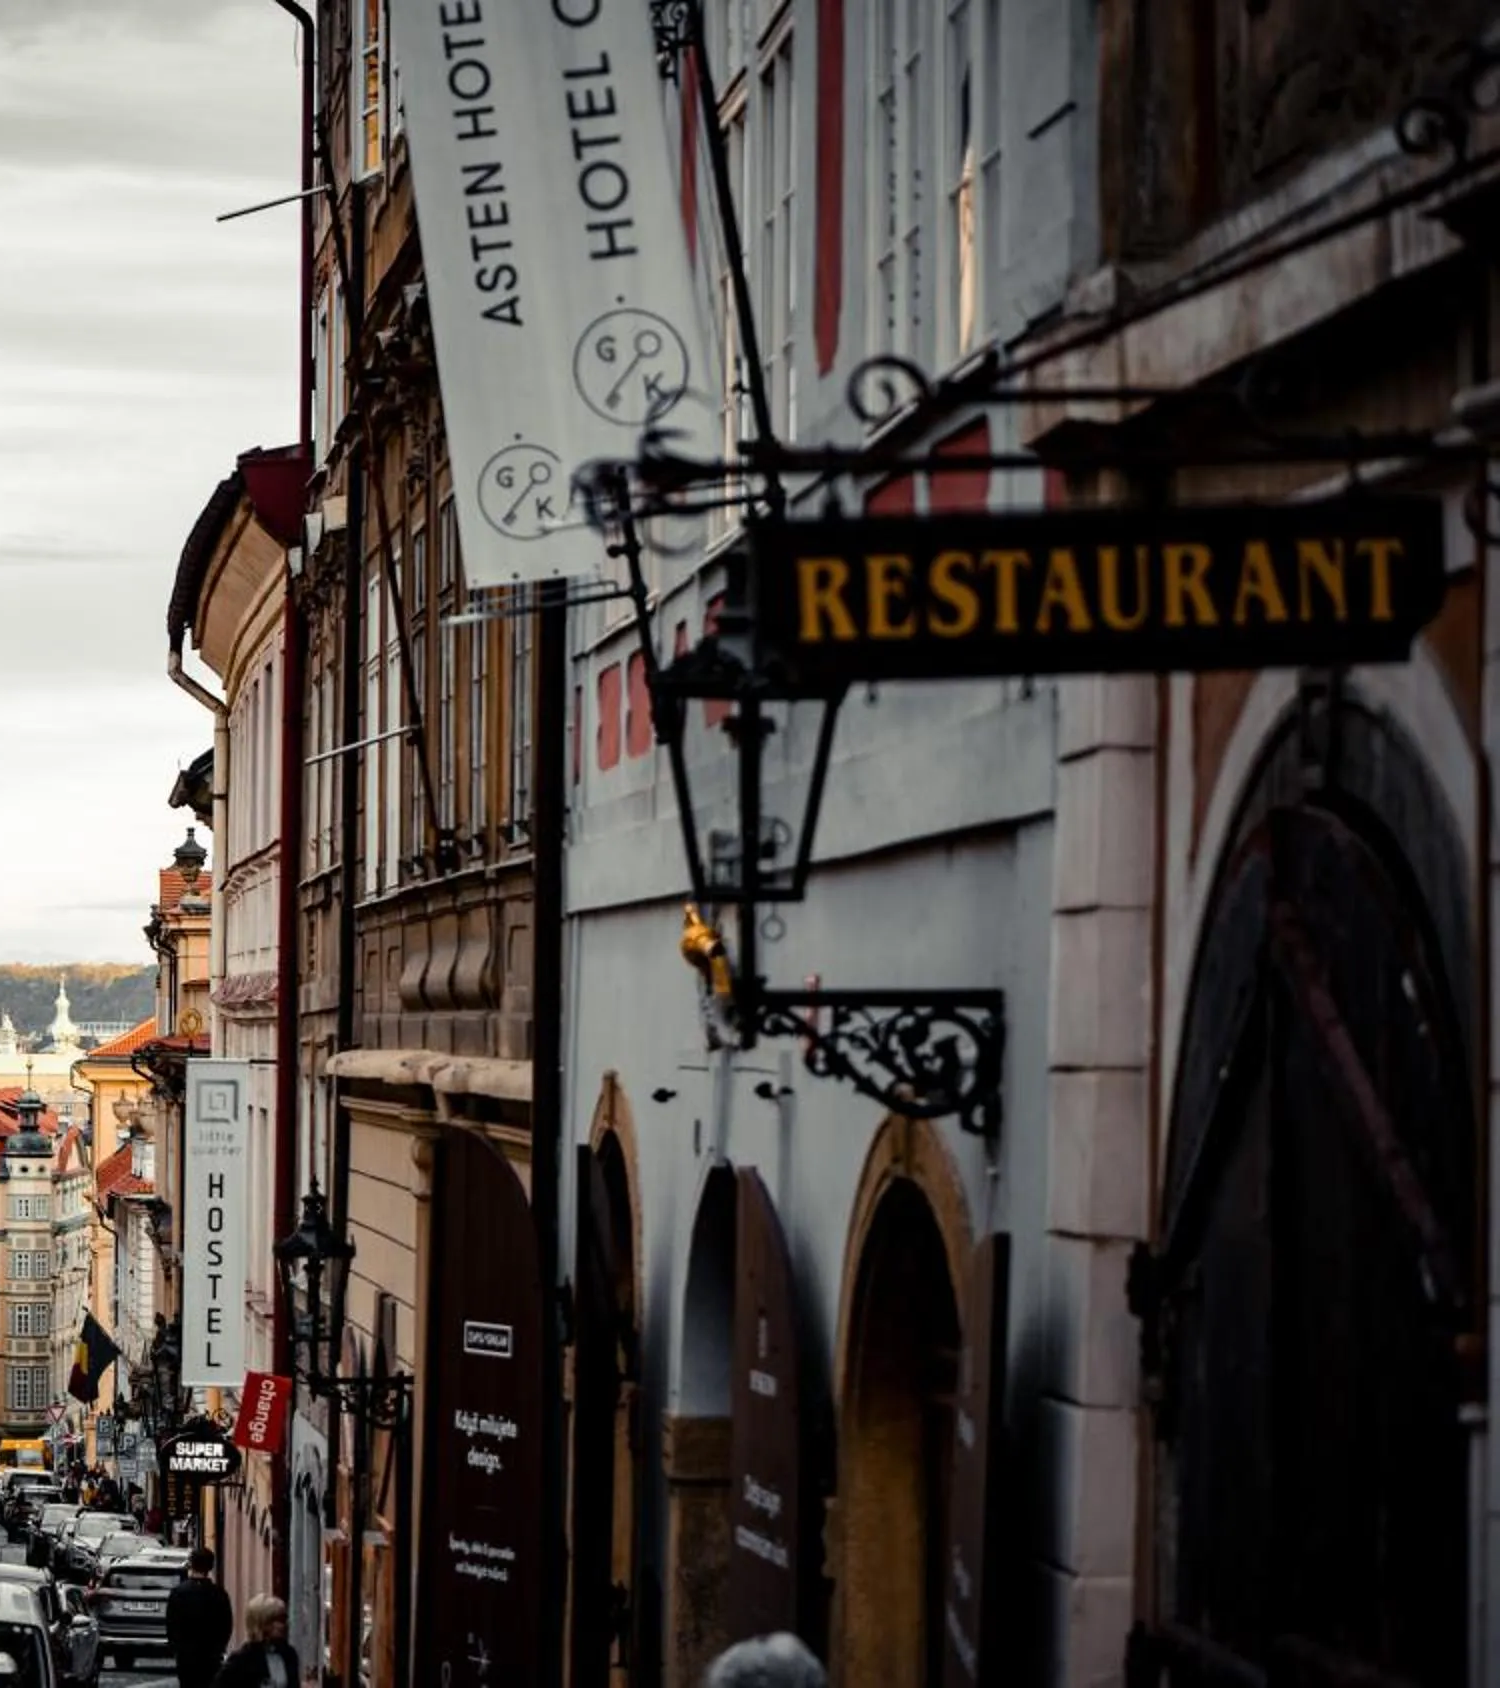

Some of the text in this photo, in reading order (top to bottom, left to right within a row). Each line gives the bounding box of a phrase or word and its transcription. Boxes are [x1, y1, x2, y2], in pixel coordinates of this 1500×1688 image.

[562, 51, 639, 260] HOTEL
[461, 162, 524, 327] ASTEN
[796, 539, 1403, 642] RESTAURANT
[205, 1173, 224, 1367] HOSTEL
[175, 1441, 225, 1457] SUPER
[248, 1379, 276, 1443] change
[169, 1457, 230, 1473] MARKET
